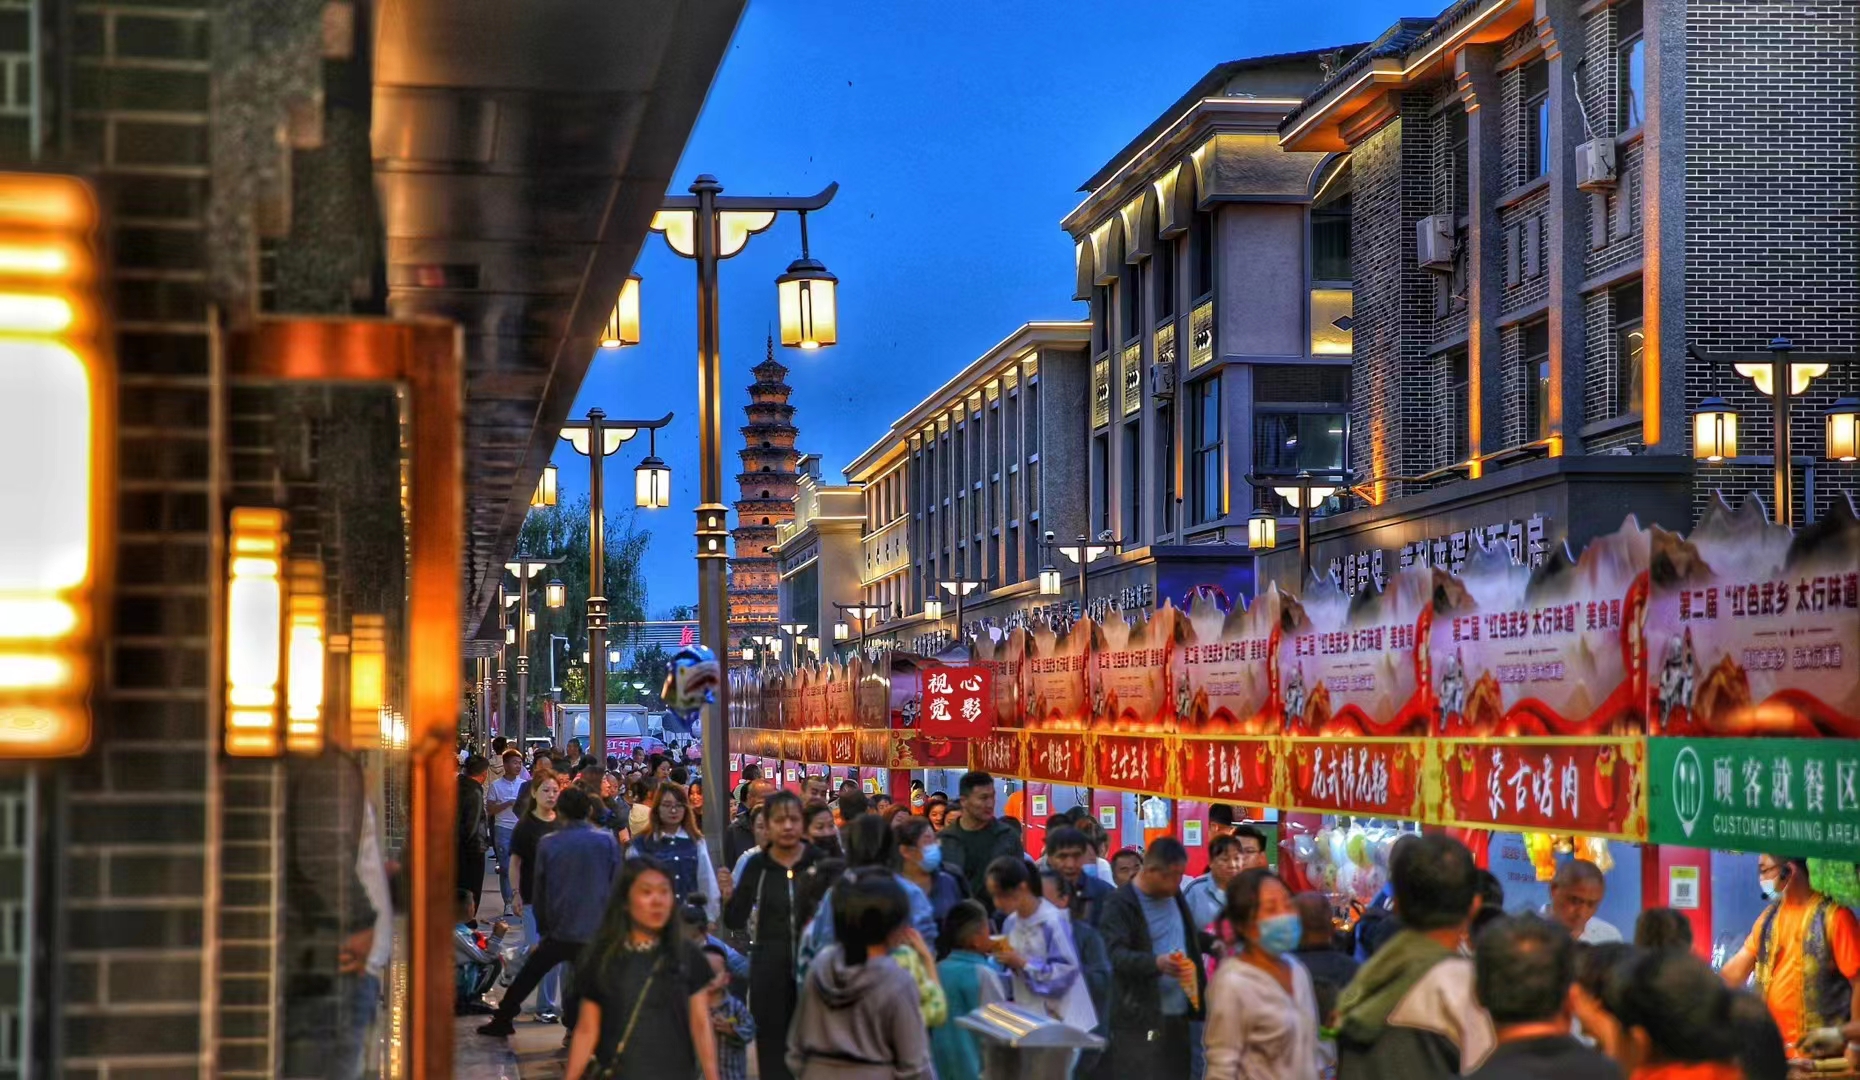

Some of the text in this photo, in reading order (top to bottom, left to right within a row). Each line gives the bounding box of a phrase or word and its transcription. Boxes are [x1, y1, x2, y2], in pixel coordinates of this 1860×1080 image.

[1453, 615, 1479, 641] 第二届
[1586, 599, 1620, 630] 美食周
[1679, 571, 1858, 620] 第二届 “红色武乡 太行味道
[1311, 744, 1389, 808] 花式棉花糖
[1487, 746, 1579, 820] 蒙古烤肉
[1713, 755, 1860, 814] 顾客就餐区
[1713, 814, 1860, 845] CUSTOMER DINING AREA
